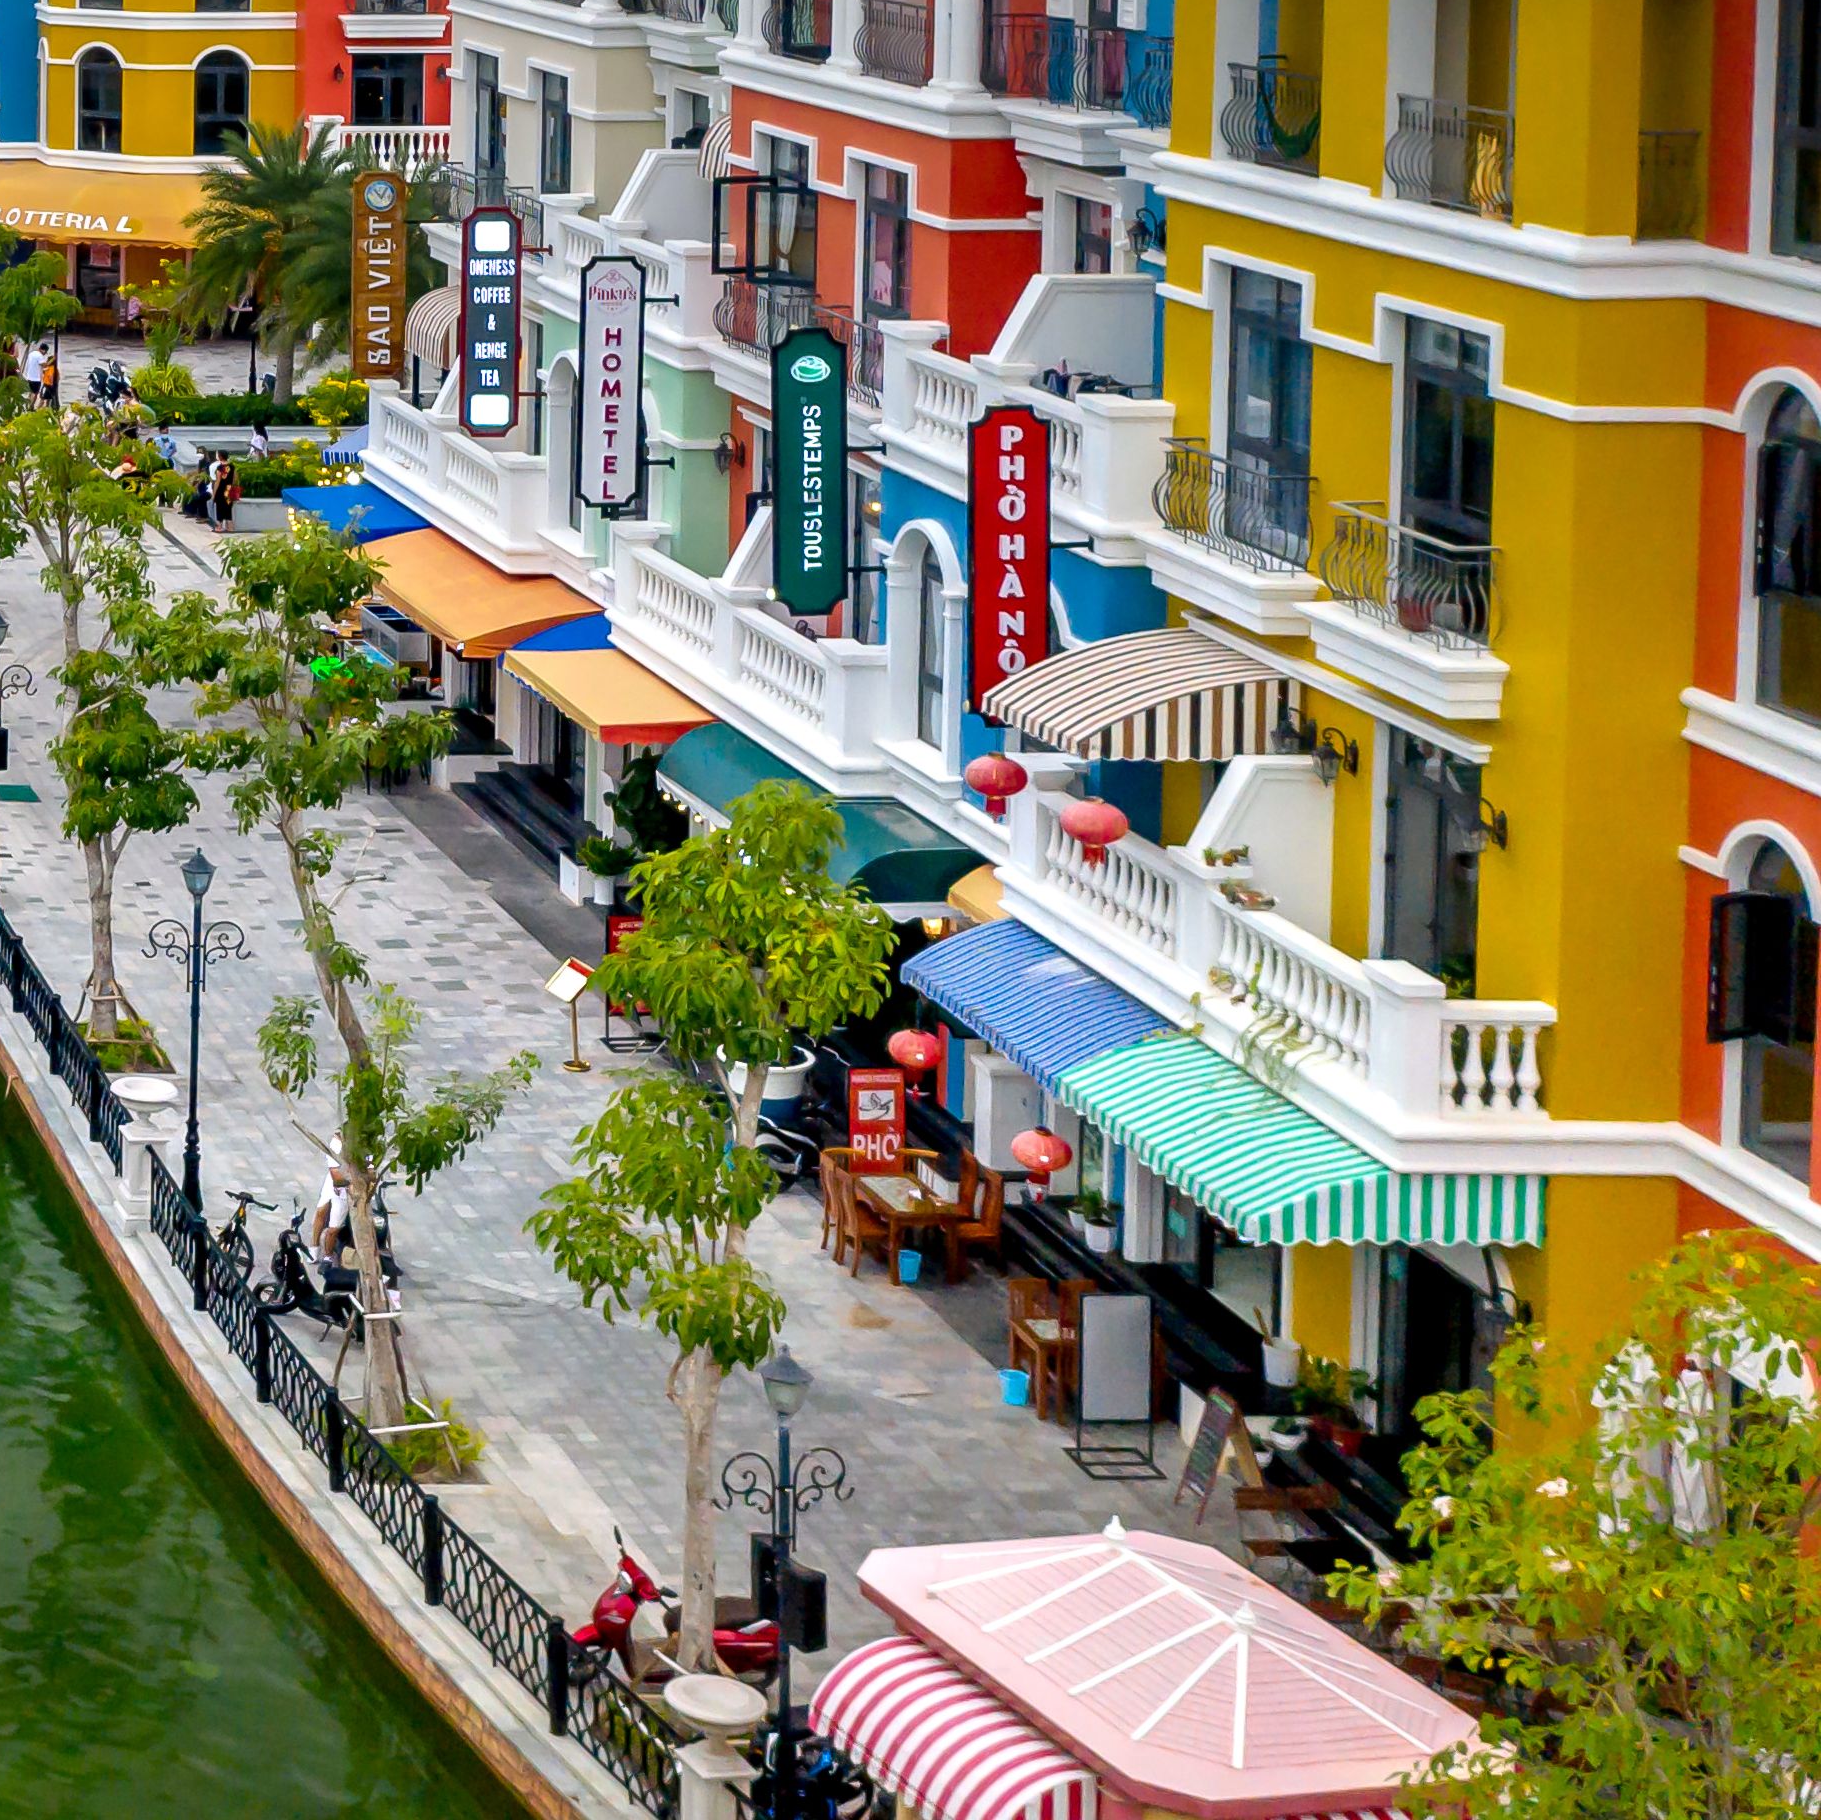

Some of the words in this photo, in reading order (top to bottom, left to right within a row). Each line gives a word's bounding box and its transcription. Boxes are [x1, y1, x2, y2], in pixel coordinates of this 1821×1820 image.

[362, 215, 397, 290] VIỆT
[469, 259, 516, 276] ONENESS
[474, 287, 511, 304] COFFEE
[487, 314, 497, 331] &
[475, 342, 507, 360] RENGE
[481, 369, 500, 387] TEA
[600, 327, 623, 501] HOMETEL
[803, 404, 823, 572] TOUSLESTEMPS
[997, 425, 1026, 522] PHỞ
[997, 534, 1026, 598] HÀ
